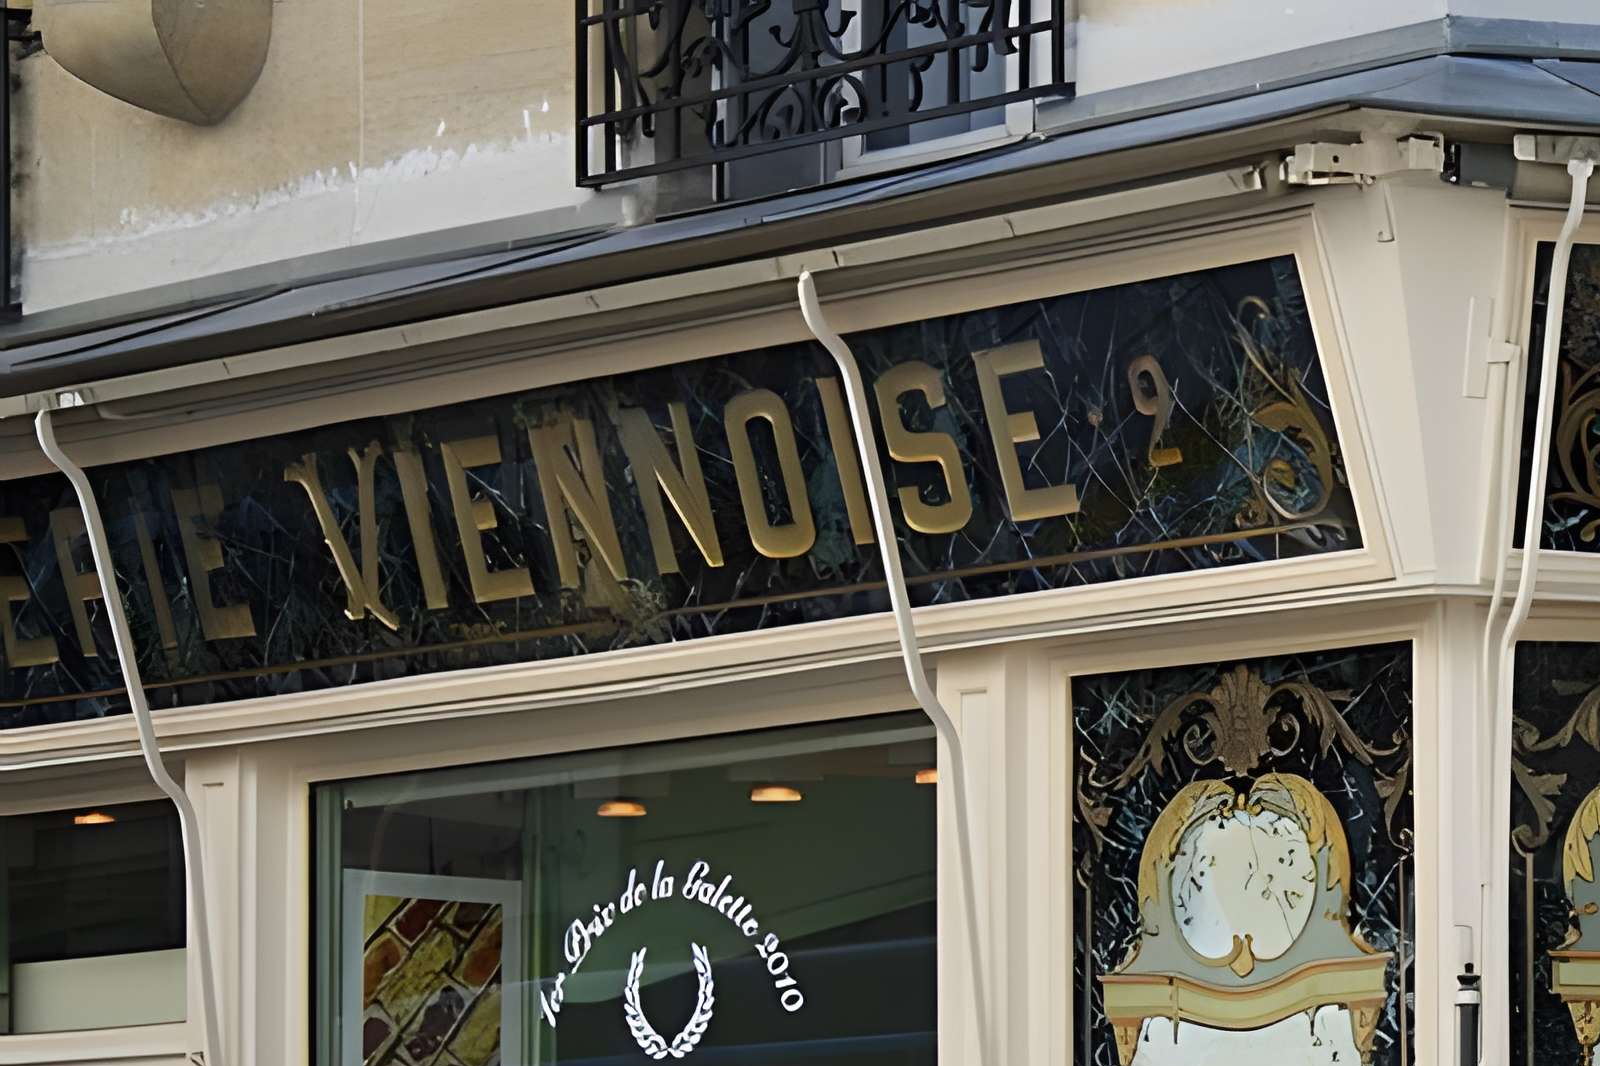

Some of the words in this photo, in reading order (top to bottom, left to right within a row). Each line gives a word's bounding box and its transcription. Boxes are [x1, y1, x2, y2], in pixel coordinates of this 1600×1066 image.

[284, 338, 1081, 631] VIENNOISE
[620, 868, 647, 914] de
[652, 860, 674, 900] la
[682, 861, 758, 936] Galette
[754, 933, 804, 1012] 2010
